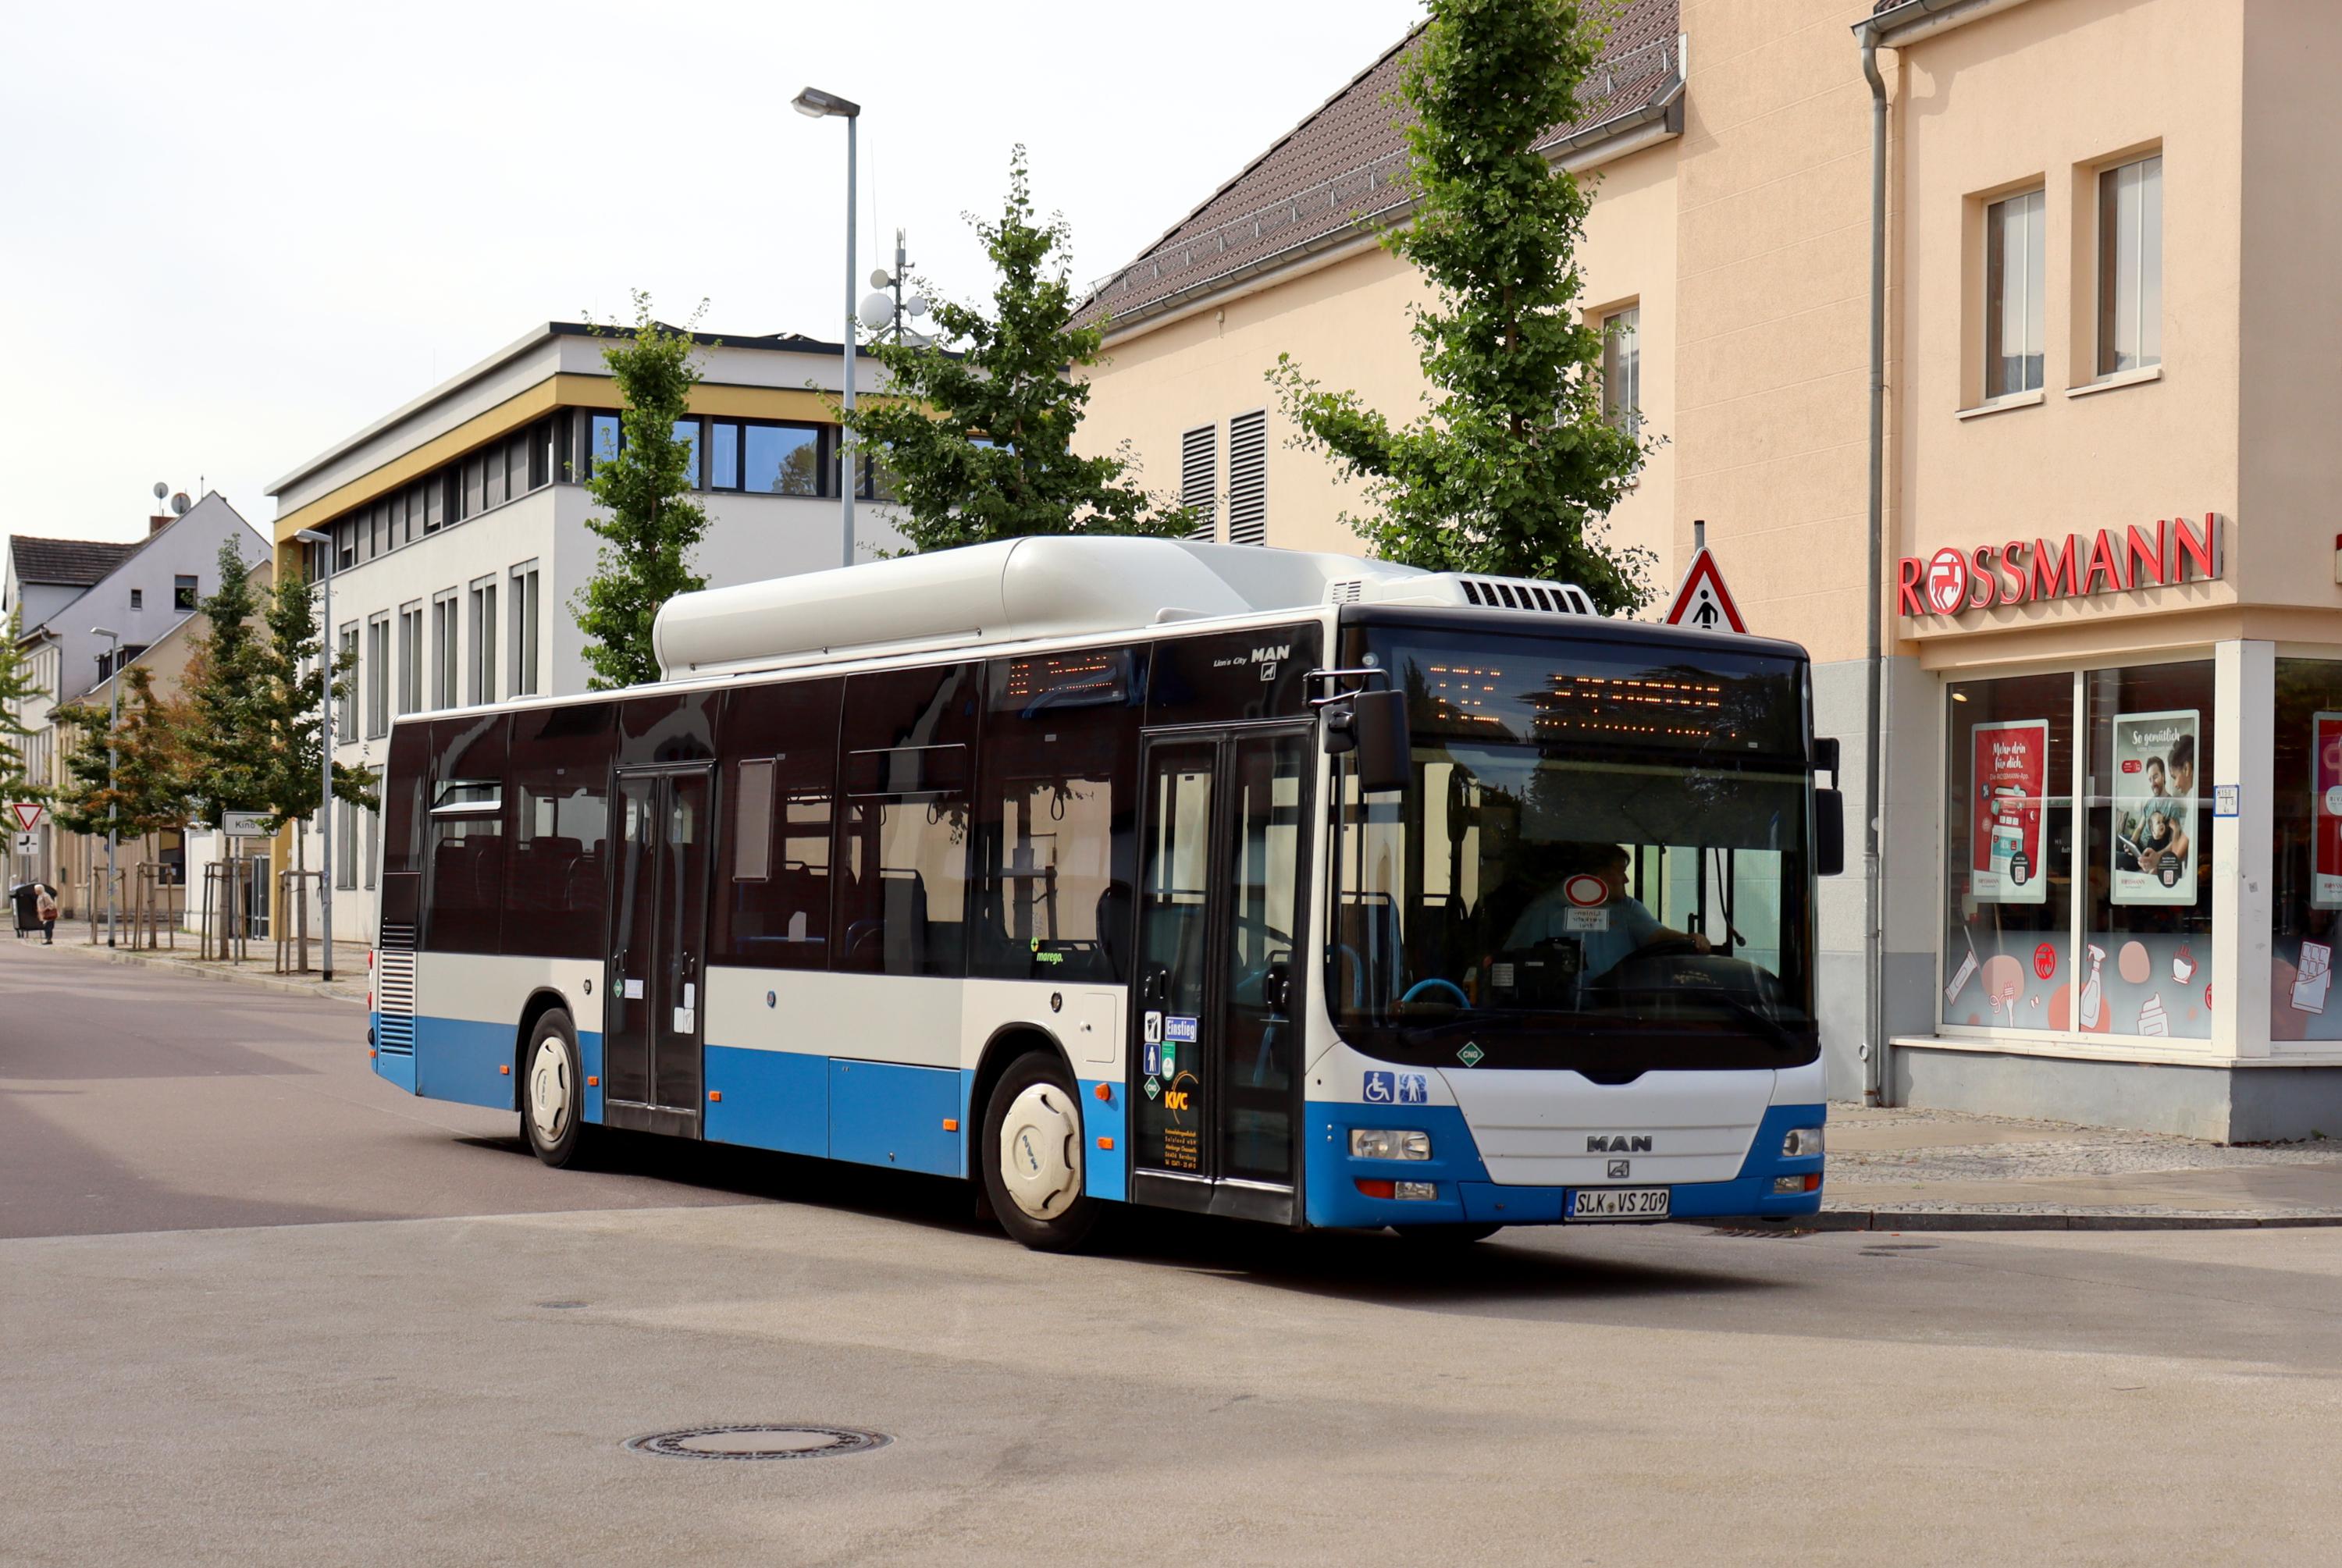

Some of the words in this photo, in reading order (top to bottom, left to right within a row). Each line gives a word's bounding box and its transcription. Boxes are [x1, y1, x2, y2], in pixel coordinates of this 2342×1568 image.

[1898, 512, 2219, 617] ROSSMANN
[1213, 659, 1231, 667] Lion's
[1233, 657, 1248, 666] City
[1251, 645, 1290, 663] MAN
[2132, 730, 2143, 745] So
[2144, 727, 2180, 747] gemütlich
[1992, 741, 2011, 756] Mehr
[2012, 741, 2027, 755] drin
[1995, 756, 2006, 773] für
[2006, 755, 2023, 769] dich.
[236, 820, 256, 829] Kino
[1037, 952, 1063, 965] marego.
[1167, 1019, 1195, 1040] Einstieg
[1586, 1136, 1653, 1153] MAN
[1576, 1193, 1607, 1214] SLK
[1618, 1193, 1637, 1212] VS
[1639, 1192, 1668, 1212] 209
